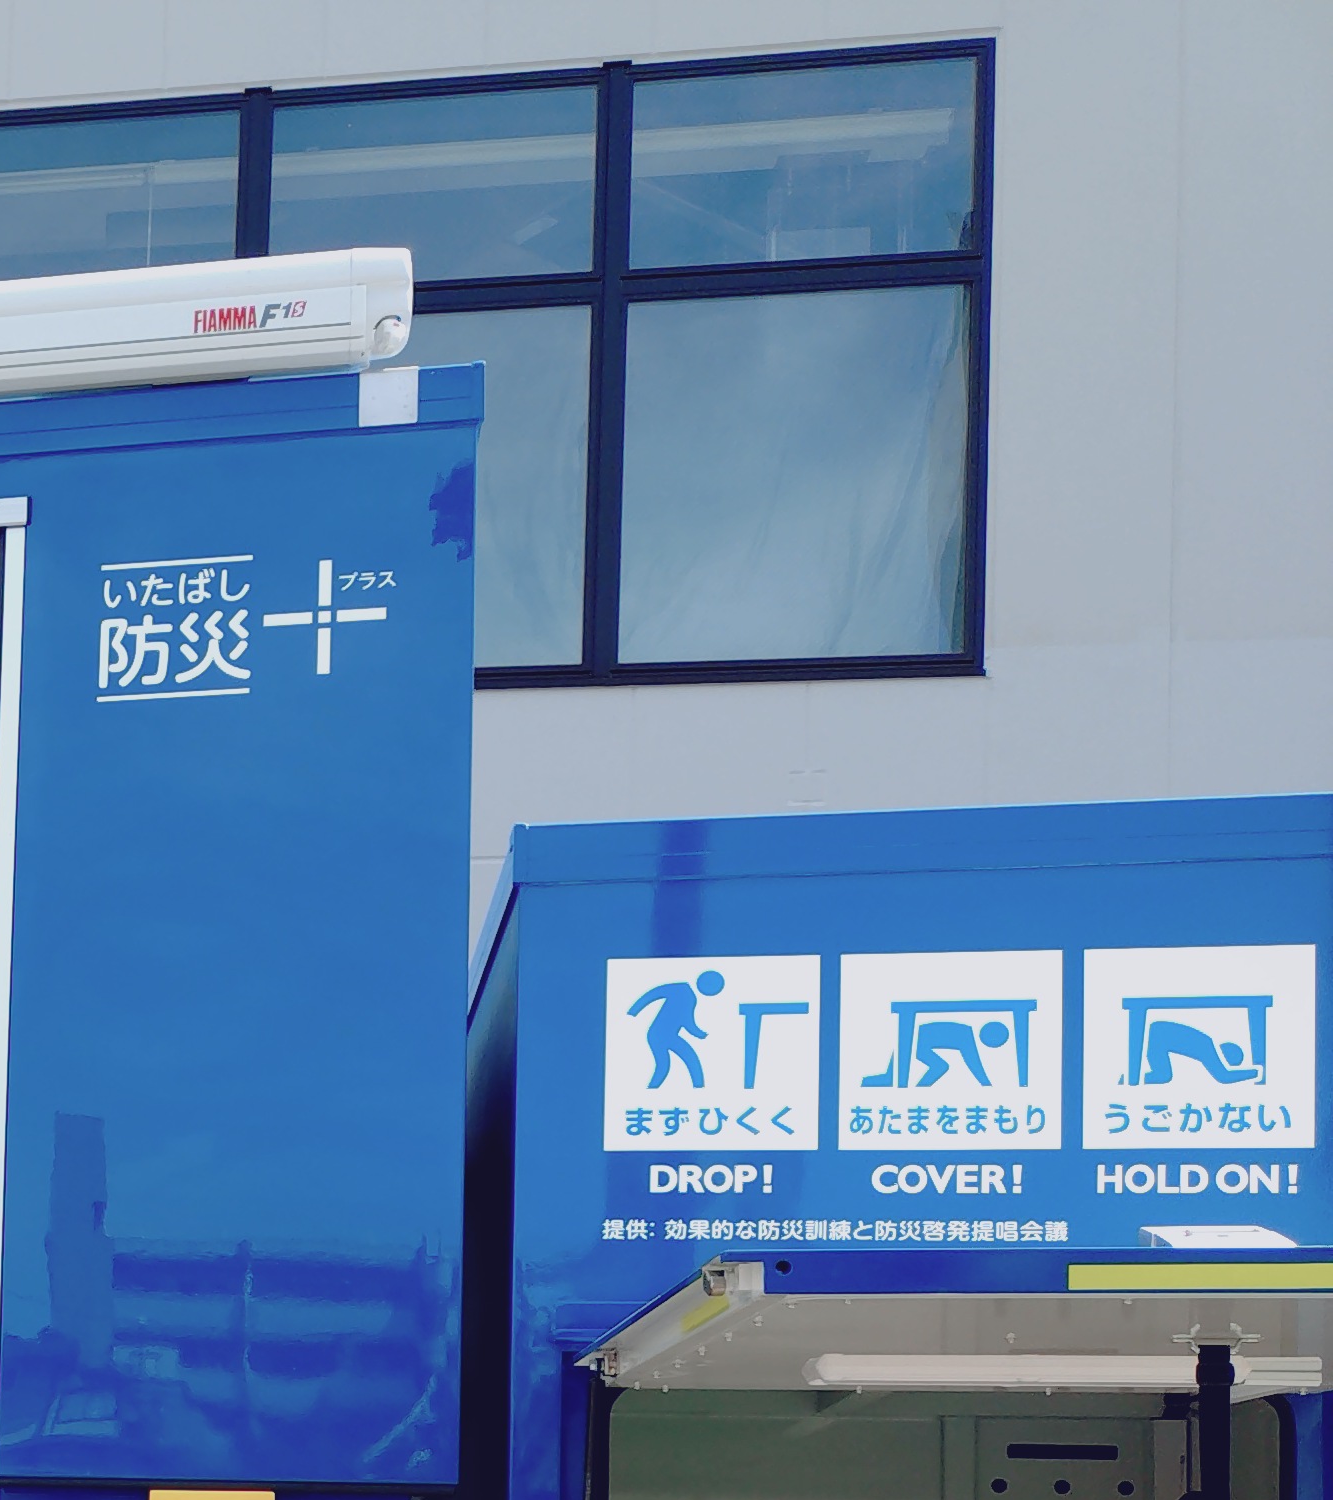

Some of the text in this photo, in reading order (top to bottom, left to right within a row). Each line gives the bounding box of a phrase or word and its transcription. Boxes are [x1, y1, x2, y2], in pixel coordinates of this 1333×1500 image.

[194, 305, 257, 333] FIAMMA
[102, 568, 251, 609] いたばし
[338, 569, 398, 592] プラス
[625, 1106, 796, 1136] まずひくく
[849, 1104, 1046, 1135] あたまをまもり
[1105, 1103, 1292, 1133] うごかない
[648, 1164, 774, 1194] DROP!
[871, 1164, 1023, 1194] COVER!
[1096, 1163, 1300, 1194] HOLD ON!
